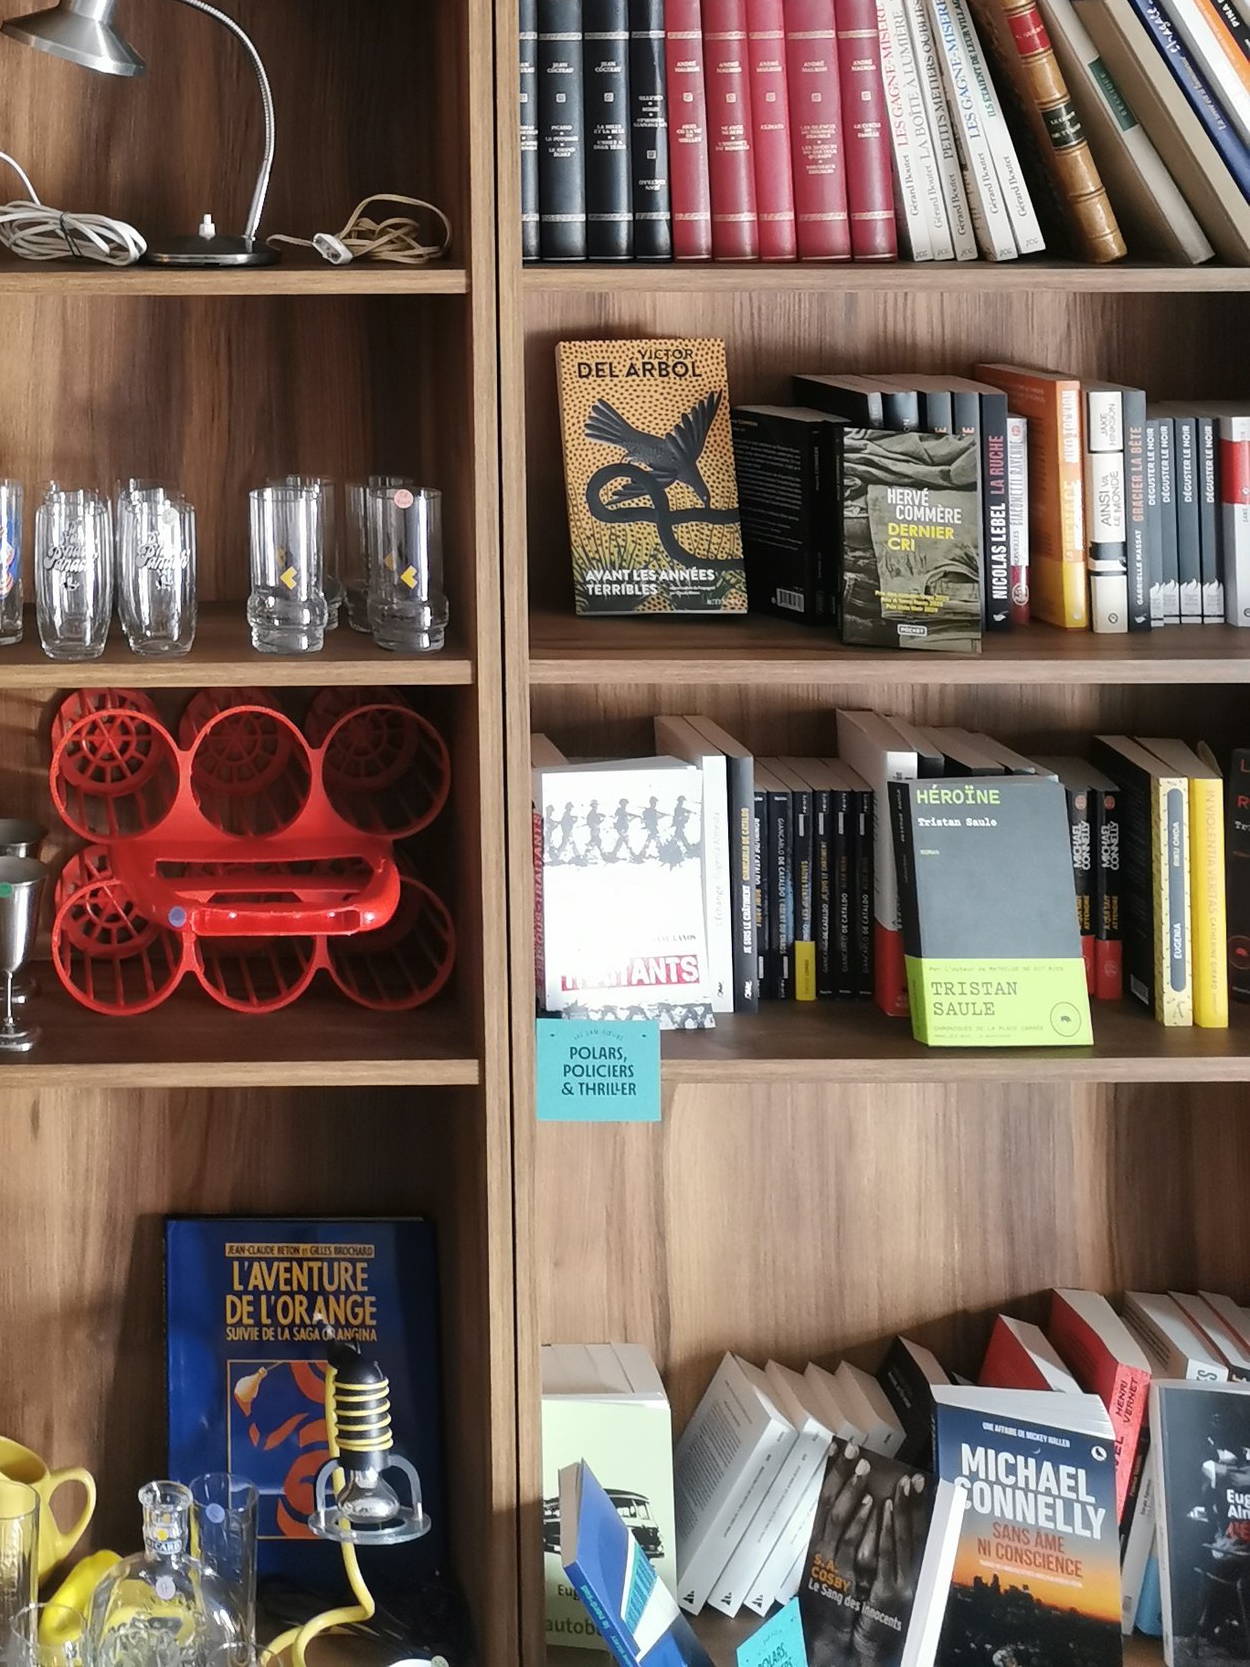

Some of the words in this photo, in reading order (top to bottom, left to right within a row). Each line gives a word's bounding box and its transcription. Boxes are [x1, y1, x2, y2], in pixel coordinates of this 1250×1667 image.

[1222, 4, 1240, 28] PINA
[894, 11, 915, 74] LUMIÈRE
[961, 32, 977, 54] LEUR
[908, 92, 926, 136] BOÎTE
[985, 103, 996, 118] ILS
[894, 122, 909, 147] LES
[936, 118, 953, 159] PETITS
[964, 112, 981, 139] LES
[918, 142, 930, 159] LA
[903, 155, 913, 184] Boutet
[925, 165, 936, 194] Boutet
[978, 152, 991, 184] Boutet
[1004, 156, 1018, 187] Boutet
[908, 184, 919, 216] Gérard
[949, 174, 960, 203] Boutet
[984, 183, 999, 214] Gérard
[1011, 187, 1027, 217] Gérard
[930, 194, 943, 228] Gérard
[953, 202, 966, 235] Gérard
[577, 362, 619, 379] DEL
[625, 356, 702, 379] ÁRBOL
[638, 349, 694, 361] VICTOR
[1100, 413, 1108, 436] JAKE
[1109, 403, 1120, 446] HINKSON
[1146, 427, 1154, 447] NOIR
[1160, 425, 1168, 446] NOIR
[1183, 425, 1191, 446] NOIR
[1205, 425, 1213, 446] NOIR
[1128, 426, 1142, 454] BÊTE
[1161, 447, 1169, 459] LE
[1183, 447, 1192, 459] LE
[1206, 447, 1214, 459] LE
[989, 435, 1003, 476] RUCHE
[1131, 457, 1143, 473] LA
[1147, 448, 1155, 461] LE
[990, 480, 1004, 494] LA
[1101, 474, 1110, 489] VA
[1110, 470, 1121, 512] MONDE
[1147, 462, 1156, 505] DÉGUSTER
[1161, 460, 1171, 503] DÉGUSTER
[1183, 459, 1193, 503] DÉGUSTER
[1206, 459, 1215, 503] DÉGUSTER
[888, 488, 929, 506] HERVÉ
[1099, 491, 1112, 526] AINSI
[1131, 476, 1144, 522] GRACIER
[896, 504, 962, 524] COMMÈRE
[990, 503, 1006, 544] LEBEL
[1113, 514, 1120, 527] LE
[888, 523, 955, 540] DERNIER
[888, 537, 915, 552] CRI
[1134, 530, 1142, 564] MASSAT
[585, 570, 632, 582] AVANT
[633, 570, 656, 581] LES
[658, 566, 716, 582] ANNÉES
[991, 545, 1008, 600] NICOLAS
[1135, 565, 1143, 605] GABRIELLE
[586, 583, 658, 596] TERRIBLES
[916, 785, 1001, 805] HÉROÏNE
[918, 817, 962, 827] Tristan
[965, 817, 998, 827] Saule
[1072, 824, 1085, 868] MICHAEL
[1082, 820, 1091, 870] CONNELLY
[1101, 824, 1113, 868] MICHAEL
[1110, 820, 1119, 870] CONNELLY
[861, 894, 869, 924] CATALDO
[743, 929, 752, 945] SUIS
[931, 981, 1017, 996] TRISTAN
[933, 1001, 995, 1016] SAULE
[570, 1046, 627, 1063] POLARS,
[563, 1064, 635, 1079] POLICIERS
[561, 1082, 574, 1096] &
[578, 1081, 637, 1096] THRILLER
[227, 1245, 275, 1255] JEAN-CLAUDE
[310, 1245, 332, 1256] GILLES
[334, 1246, 373, 1256] BROCHARD
[233, 1261, 368, 1292] L'AVENTURE
[226, 1294, 254, 1325] DE
[260, 1294, 377, 1326] L'ORANGE
[226, 1327, 260, 1341] SUIVIE
[262, 1327, 275, 1341] DE
[277, 1327, 291, 1341] LA
[293, 1327, 320, 1341] SAGA
[1116, 1380, 1128, 1417] HENRI
[1123, 1377, 1138, 1424] VERNET
[1025, 1431, 1048, 1443] MICKEY
[1048, 1436, 1070, 1448] HALLER
[961, 1443, 1096, 1504] MICHAEL
[992, 1521, 1030, 1546] SANS
[1034, 1529, 1065, 1554] ÂME
[814, 1553, 825, 1565] S.
[825, 1560, 839, 1573] A.
[977, 1538, 991, 1556] NI
[995, 1542, 1083, 1578] CONSCIENCE
[811, 1566, 851, 1592] COSBY
[808, 1577, 819, 1592] Le
[821, 1584, 843, 1605] Sang
[843, 1596, 861, 1612] des
